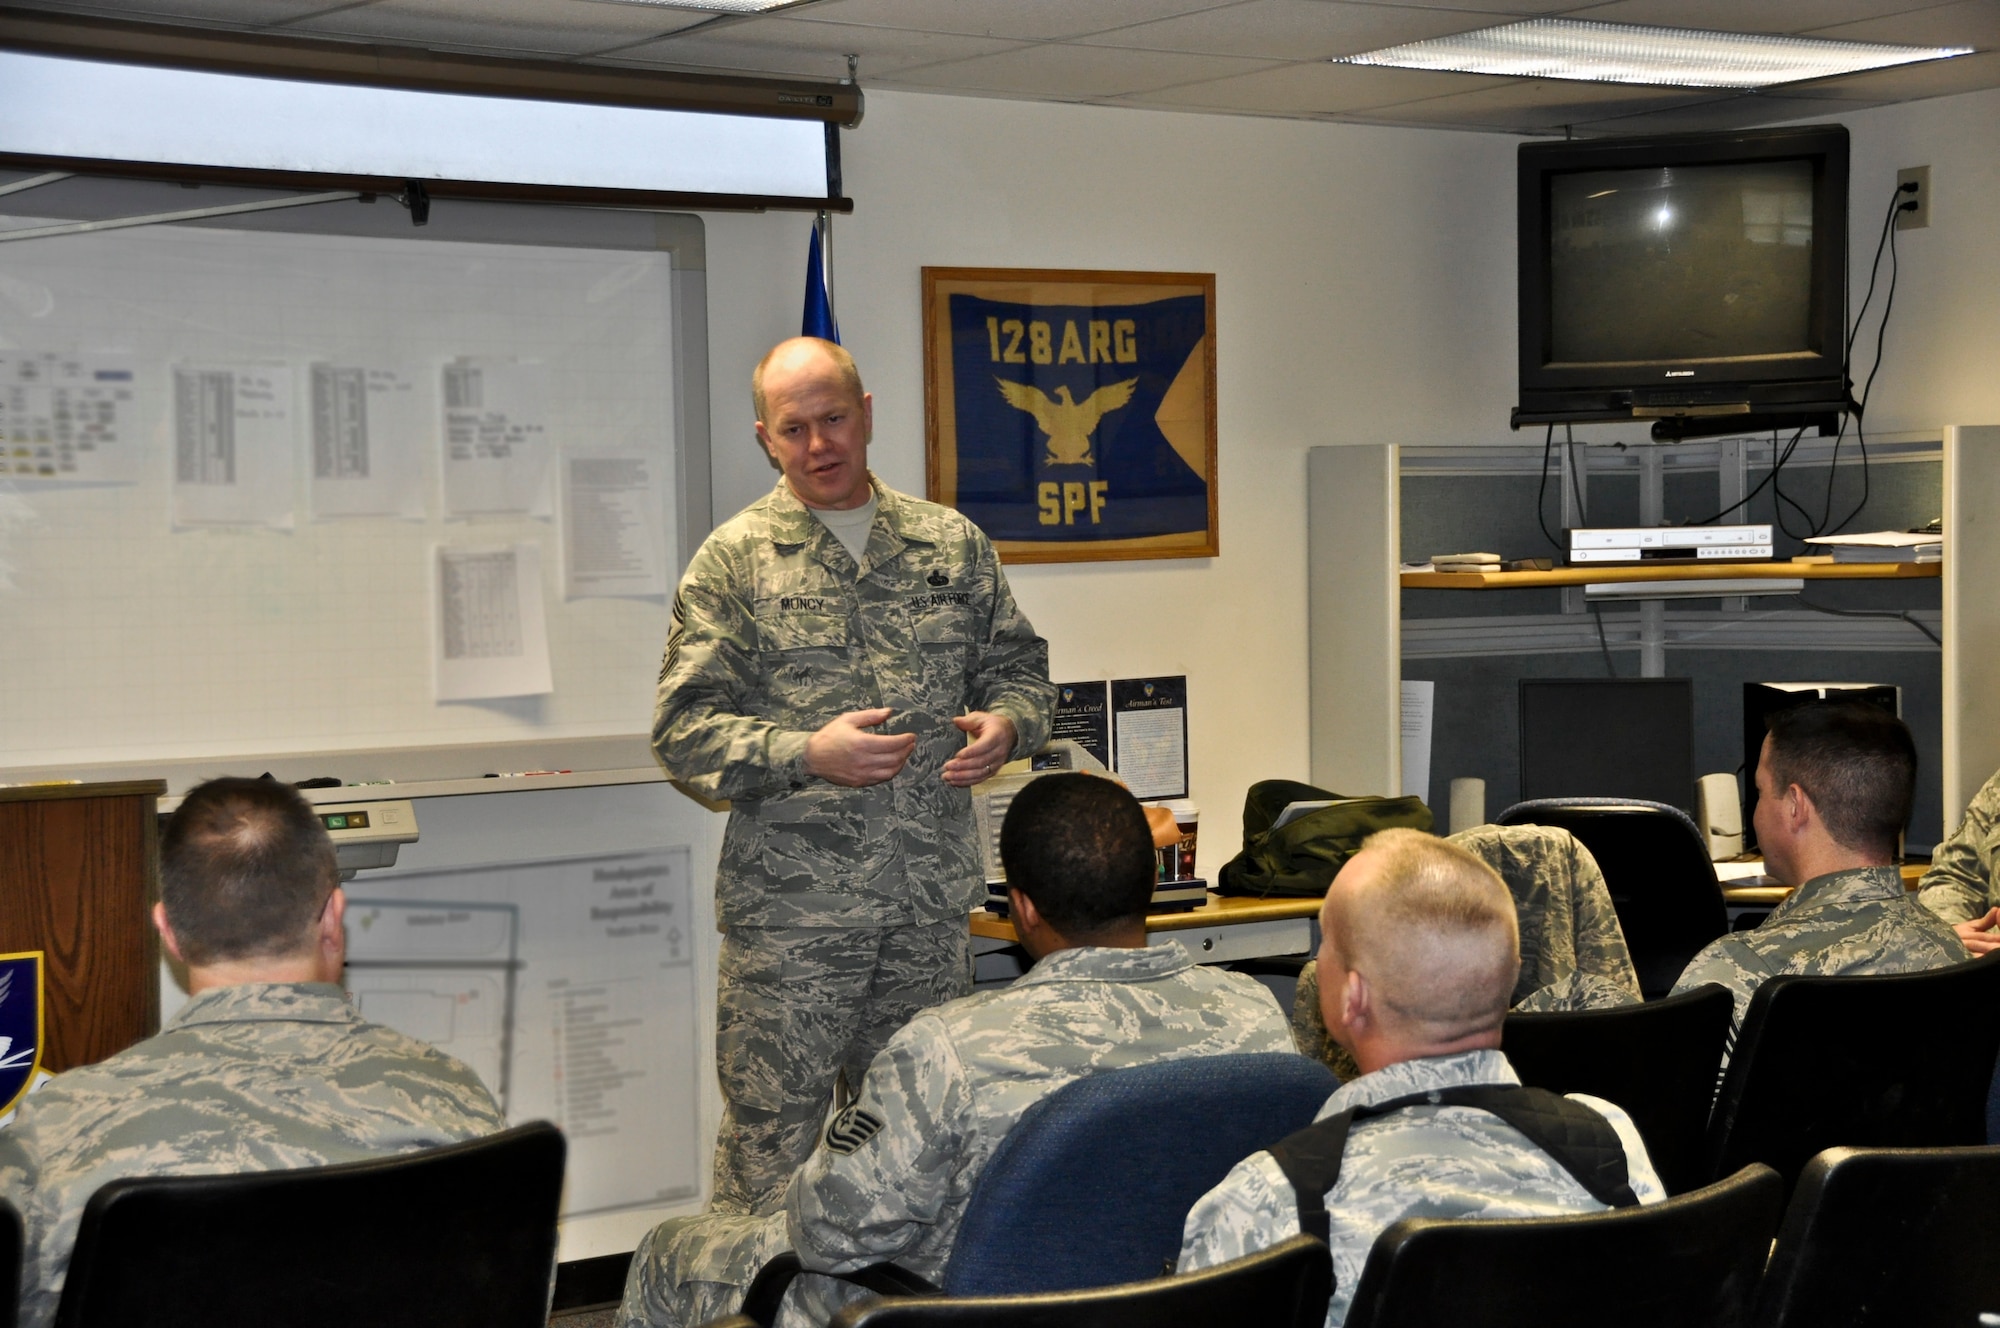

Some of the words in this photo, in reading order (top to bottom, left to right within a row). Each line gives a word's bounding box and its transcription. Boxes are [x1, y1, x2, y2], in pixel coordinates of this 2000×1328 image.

[1038, 480, 1108, 525] SPF
[781, 597, 824, 611] MUNCY
[1125, 698, 1157, 709] Airman's
